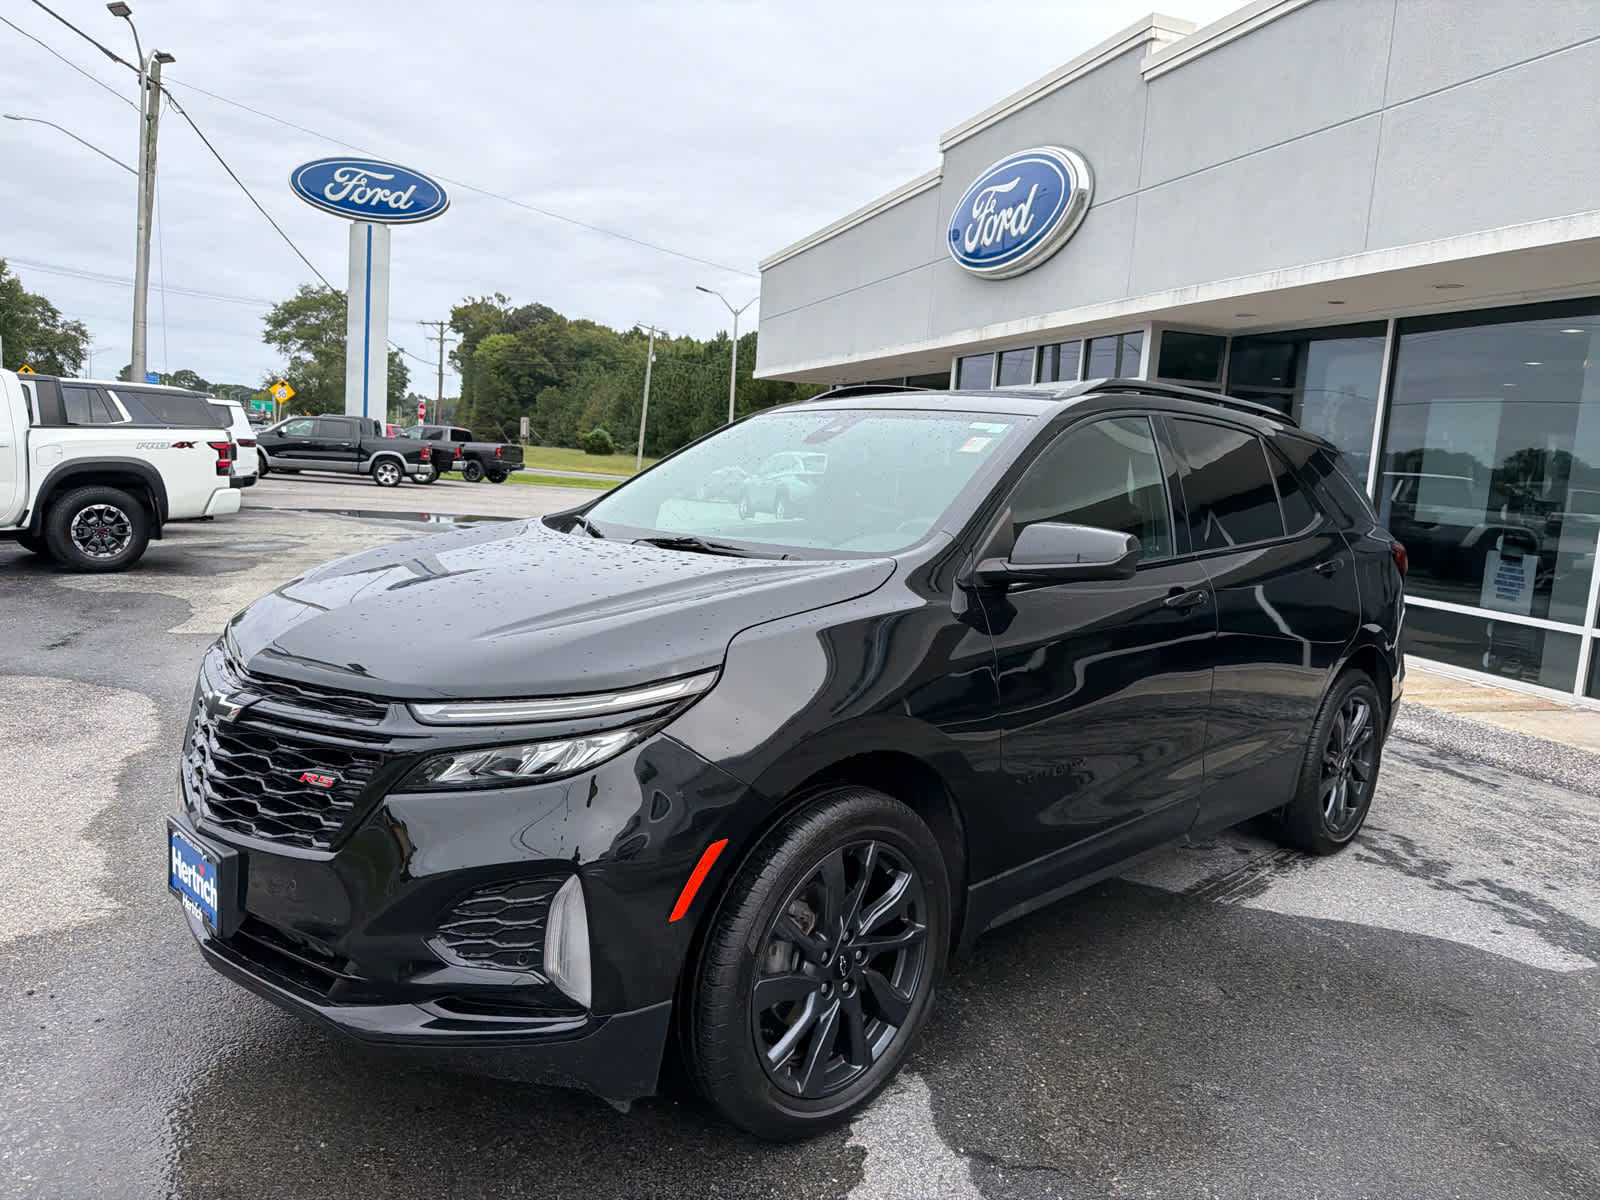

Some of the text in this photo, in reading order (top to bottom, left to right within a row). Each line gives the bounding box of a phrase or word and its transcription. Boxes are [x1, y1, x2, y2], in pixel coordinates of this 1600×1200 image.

[324, 167, 417, 210] Ford
[964, 176, 1040, 253] Ford
[299, 772, 336, 788] RS
[171, 845, 218, 912] Hertrich
